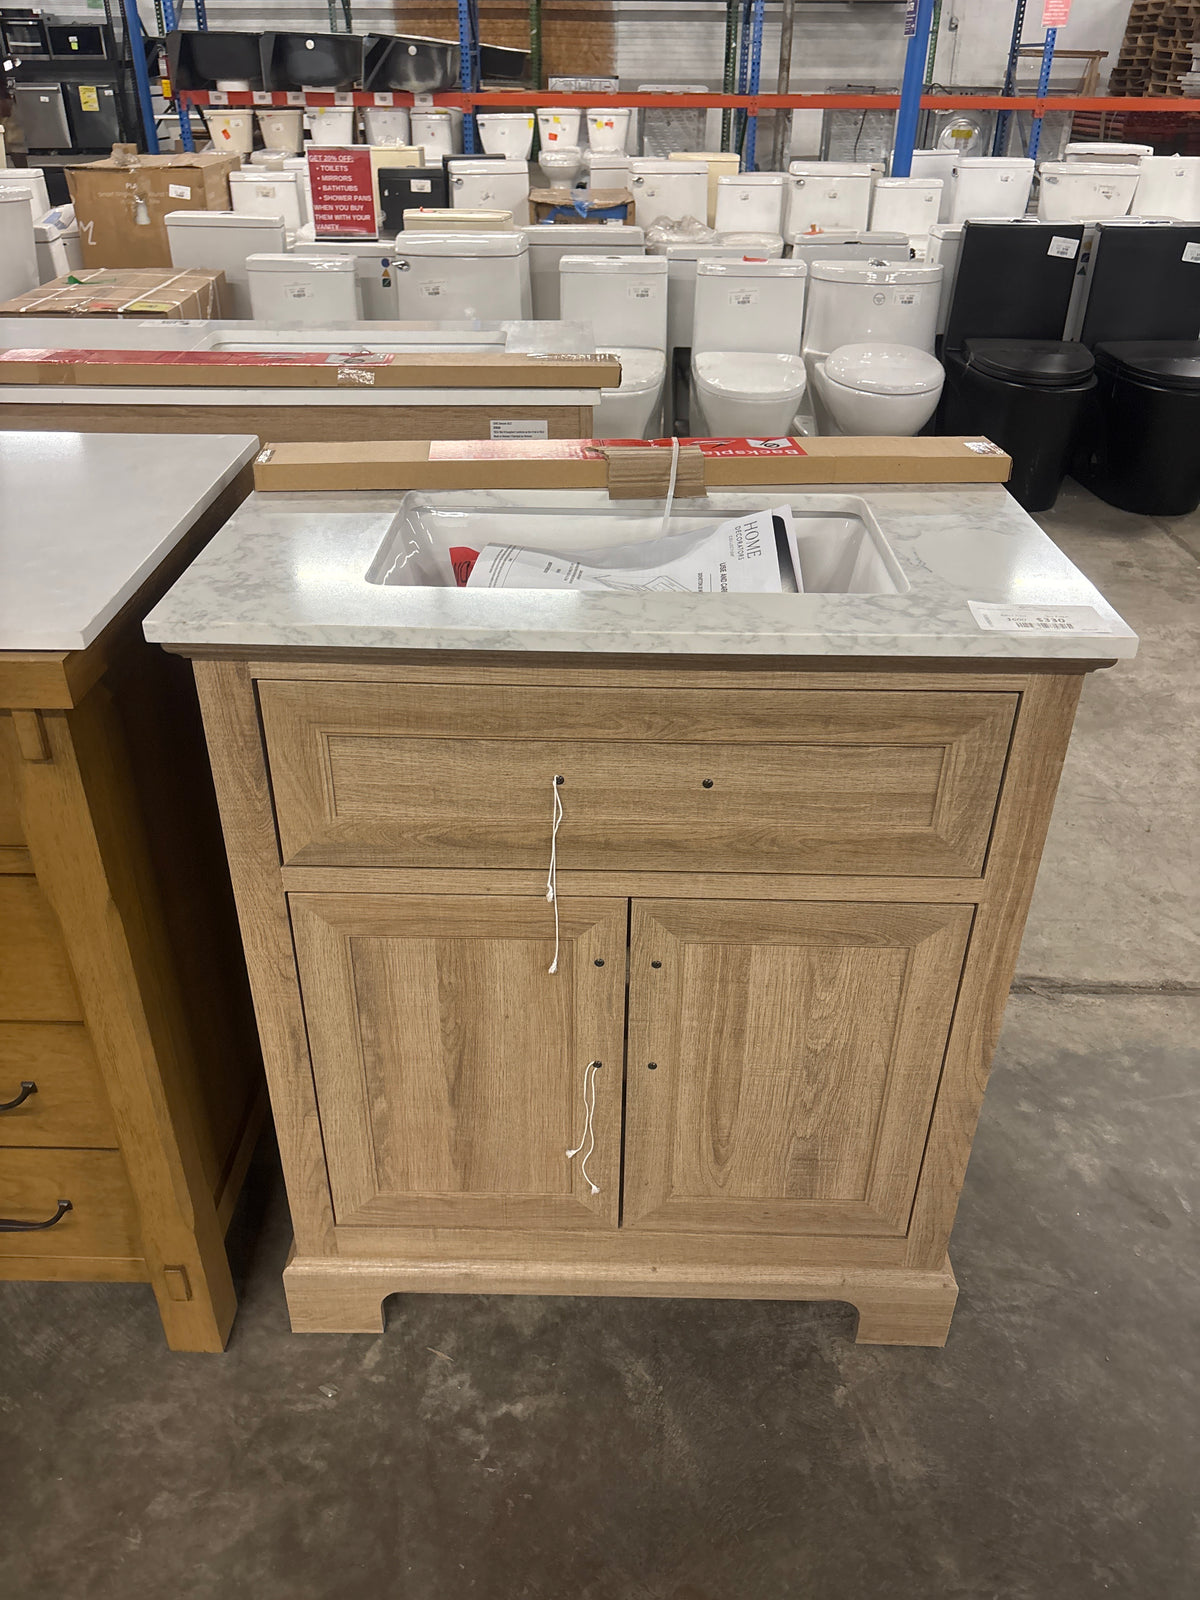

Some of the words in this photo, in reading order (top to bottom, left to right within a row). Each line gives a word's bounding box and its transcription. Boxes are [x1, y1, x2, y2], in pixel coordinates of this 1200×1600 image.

[320, 164, 349, 172] TOILETS
[734, 525, 745, 561] DECORATORS
[744, 520, 762, 559] HOME
[719, 562, 727, 573] USE
[720, 573, 728, 583] AND
[720, 583, 728, 593] CAR
